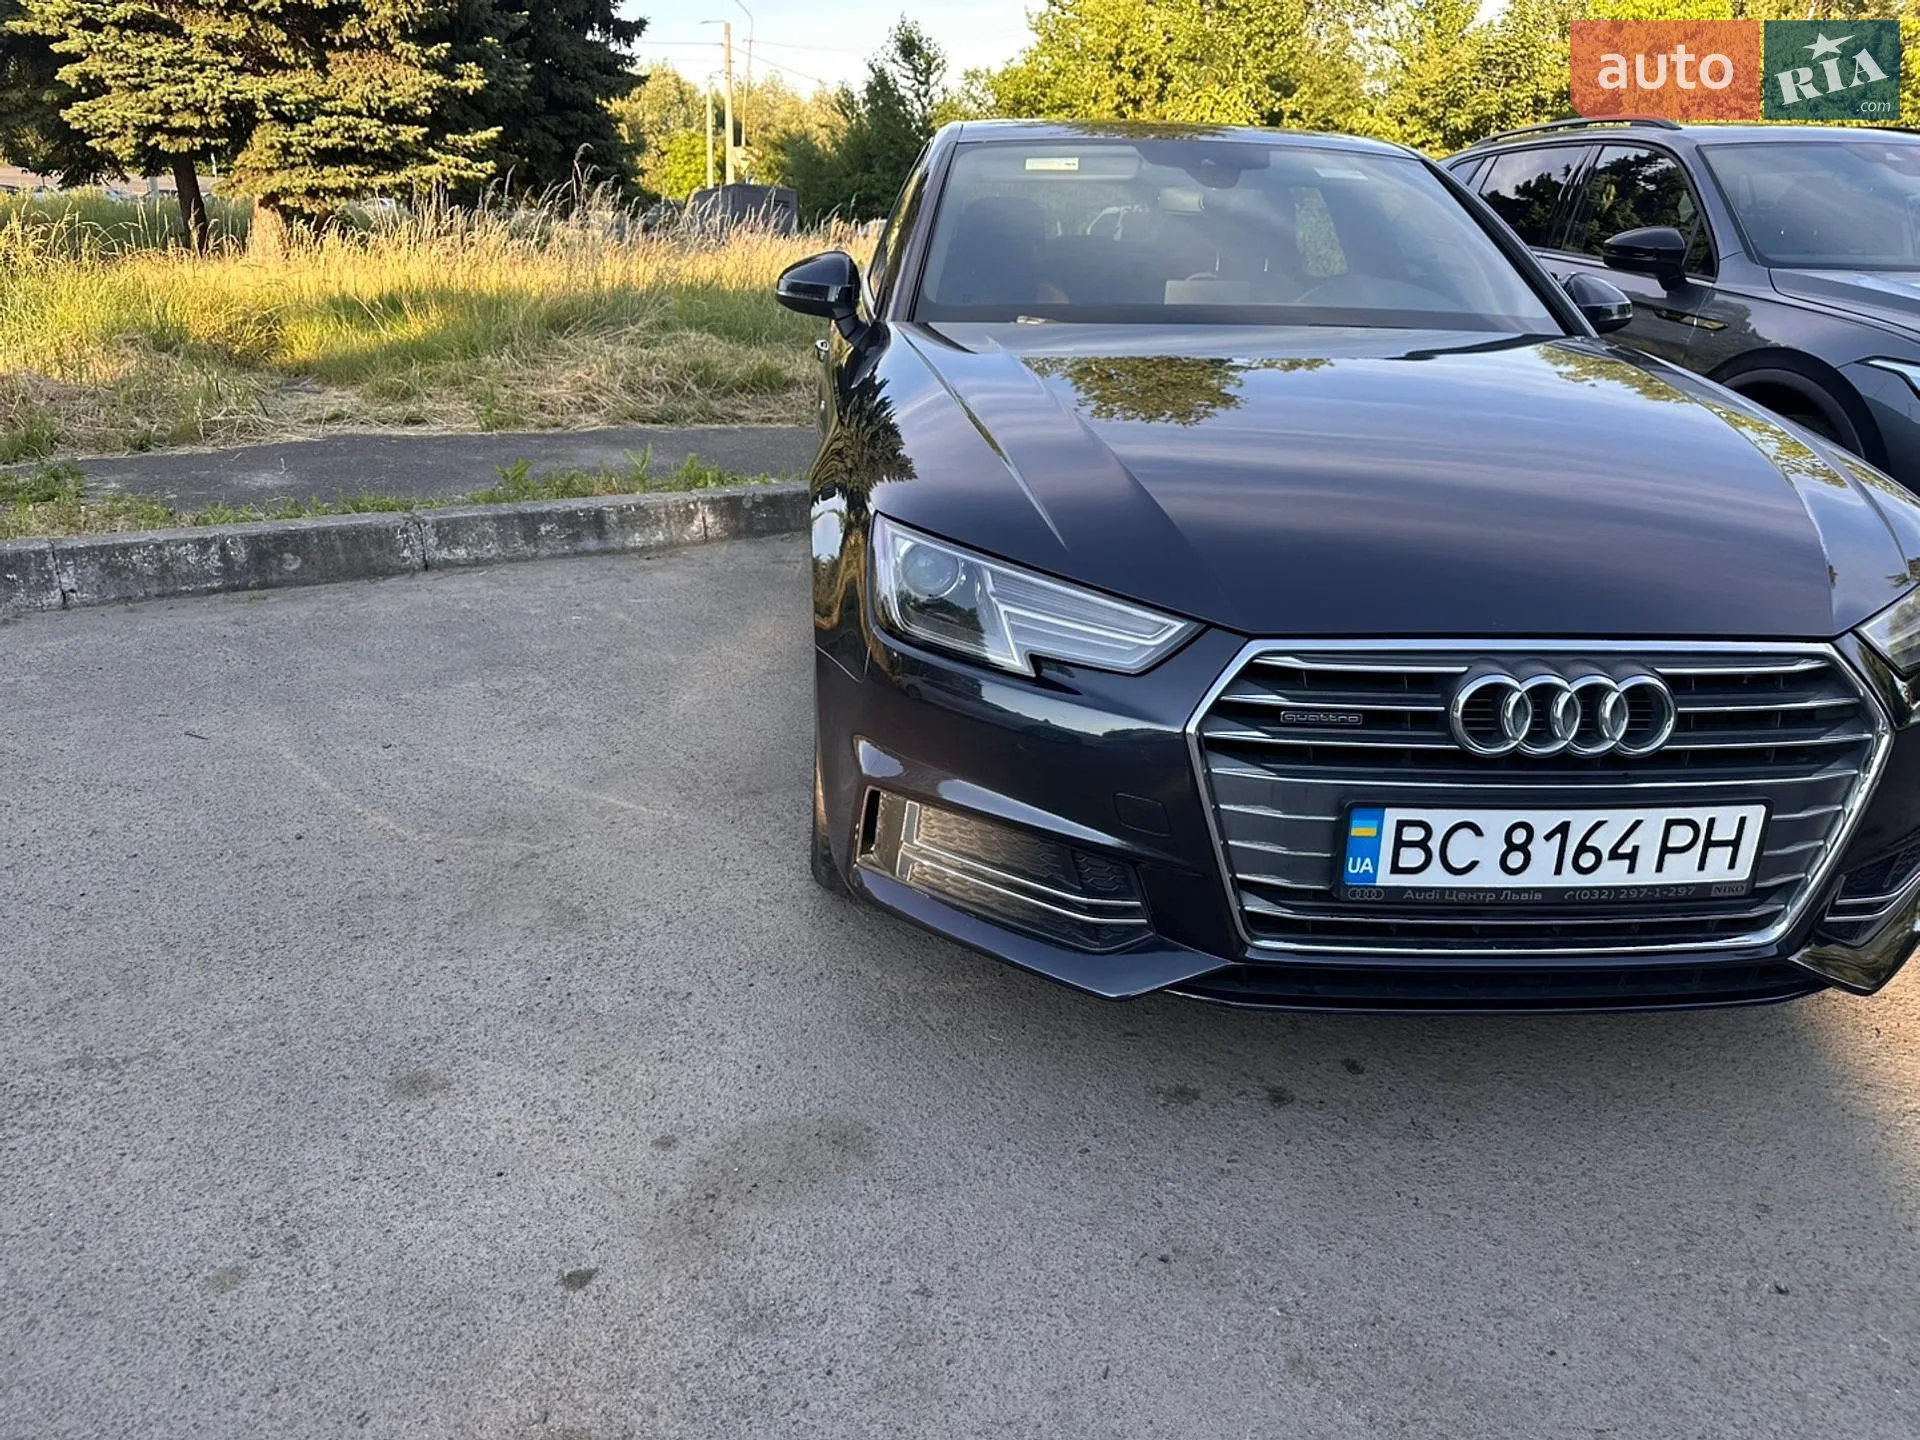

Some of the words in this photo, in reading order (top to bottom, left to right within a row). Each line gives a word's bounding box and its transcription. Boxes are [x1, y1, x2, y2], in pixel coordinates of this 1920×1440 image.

[1284, 713, 1359, 723] quattro
[1389, 818, 1484, 876] BC
[1499, 819, 1643, 876] 8164
[1654, 816, 1747, 873] PH
[1347, 857, 1374, 873] UA
[1402, 888, 1440, 900] Audi
[1445, 889, 1496, 902] Центр
[1500, 889, 1542, 901] Львів
[1619, 886, 1696, 899] 297-1-297
